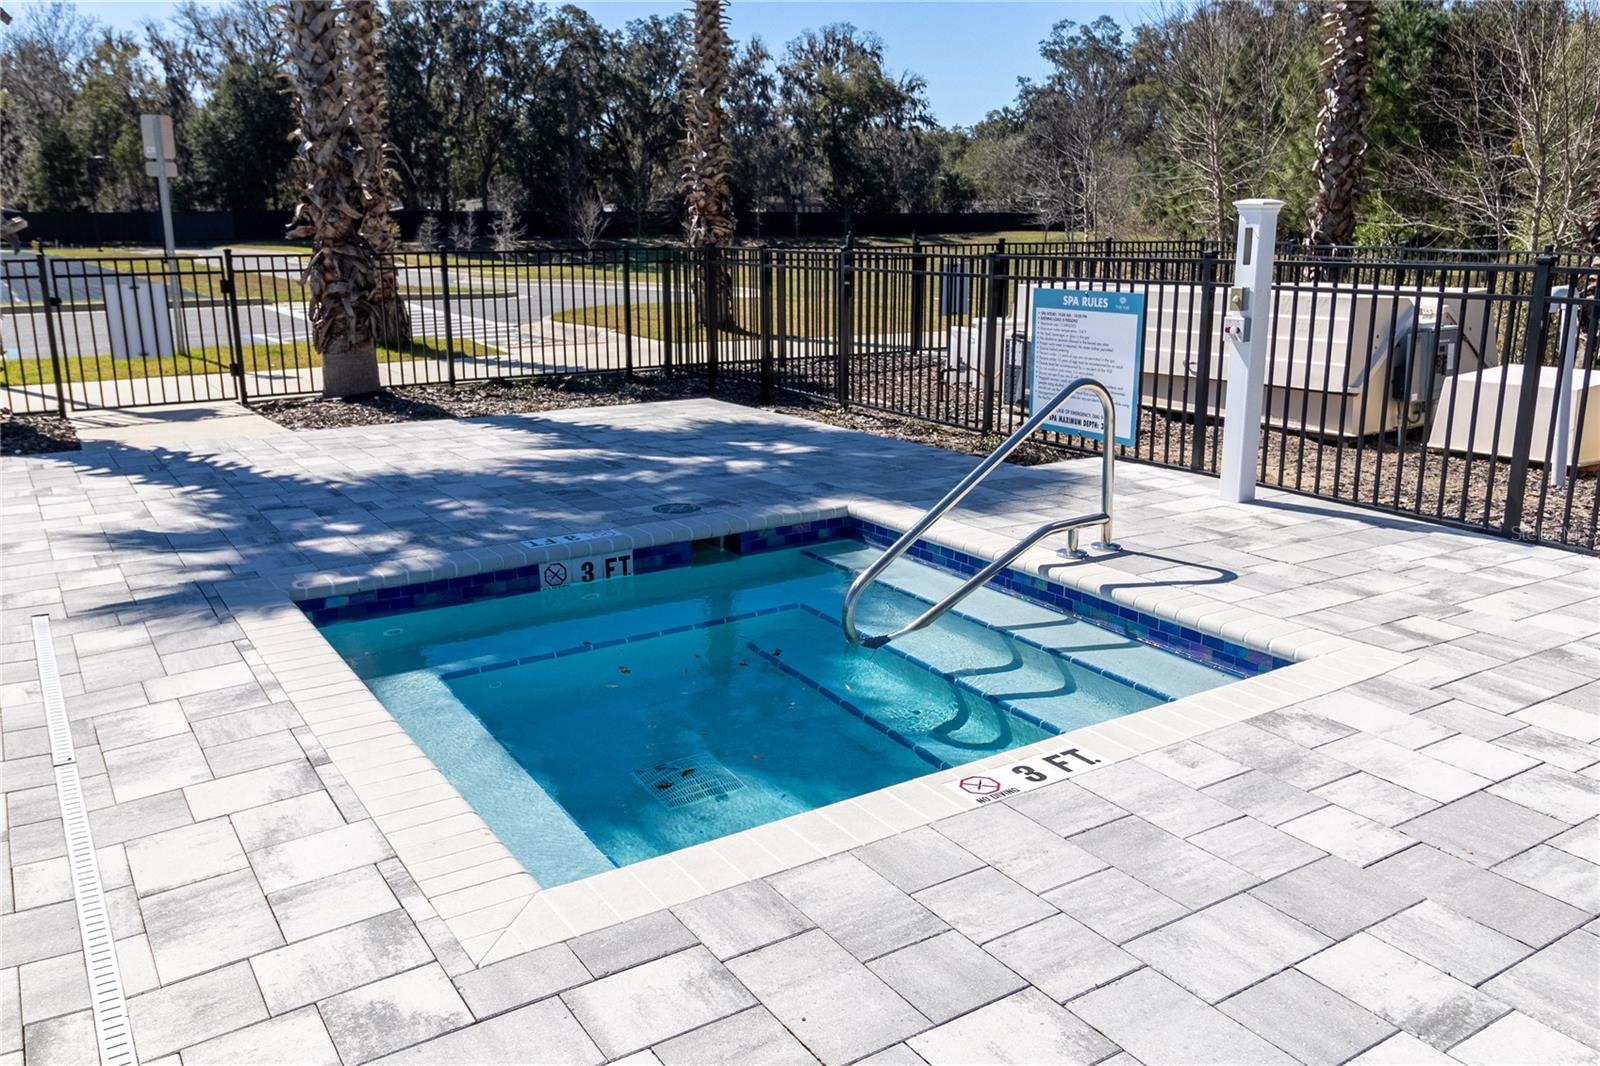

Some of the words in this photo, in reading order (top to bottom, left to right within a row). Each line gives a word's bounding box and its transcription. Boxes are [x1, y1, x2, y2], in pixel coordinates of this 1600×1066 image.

[1063, 295, 1080, 306] SPA
[1082, 297, 1109, 308] RULES
[1058, 416, 1082, 425] MAXIMUM
[1082, 420, 1100, 429] DEPTH:
[581, 562, 594, 582] 3
[1012, 766, 1048, 782] 3
[1042, 748, 1102, 772] FT.
[976, 796, 992, 804] NO
[990, 787, 1020, 800] DIVING
